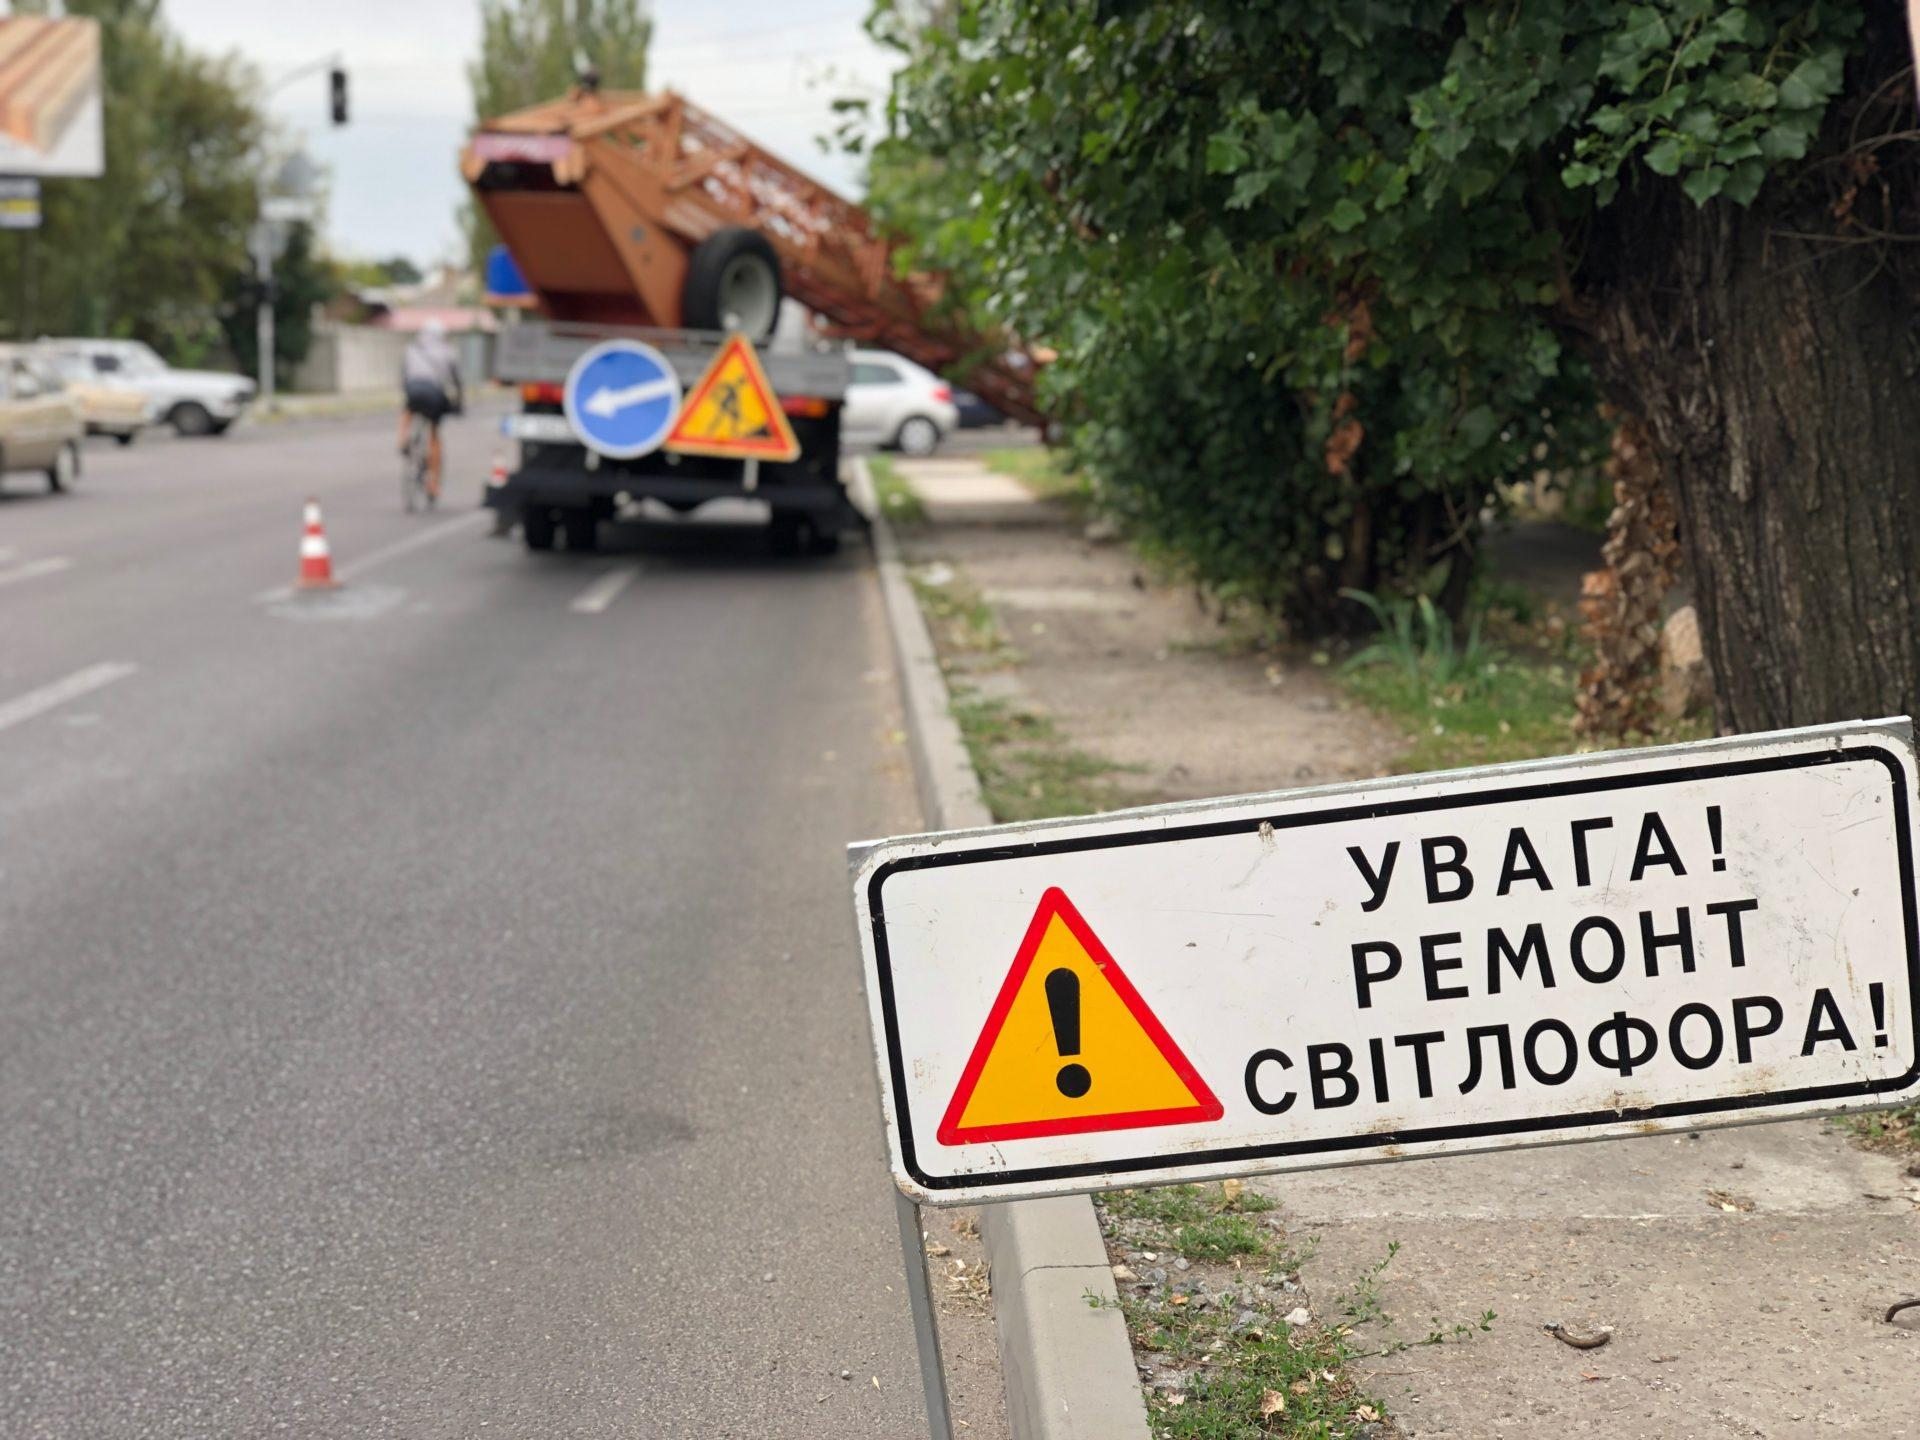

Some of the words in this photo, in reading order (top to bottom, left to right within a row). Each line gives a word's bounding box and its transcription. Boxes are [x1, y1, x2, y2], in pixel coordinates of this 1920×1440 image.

[1345, 805, 1728, 913] УВАГА!
[1351, 898, 1759, 1009] РЕМОНТ
[1244, 982, 1890, 1116] СВІТЛОФОРА!
